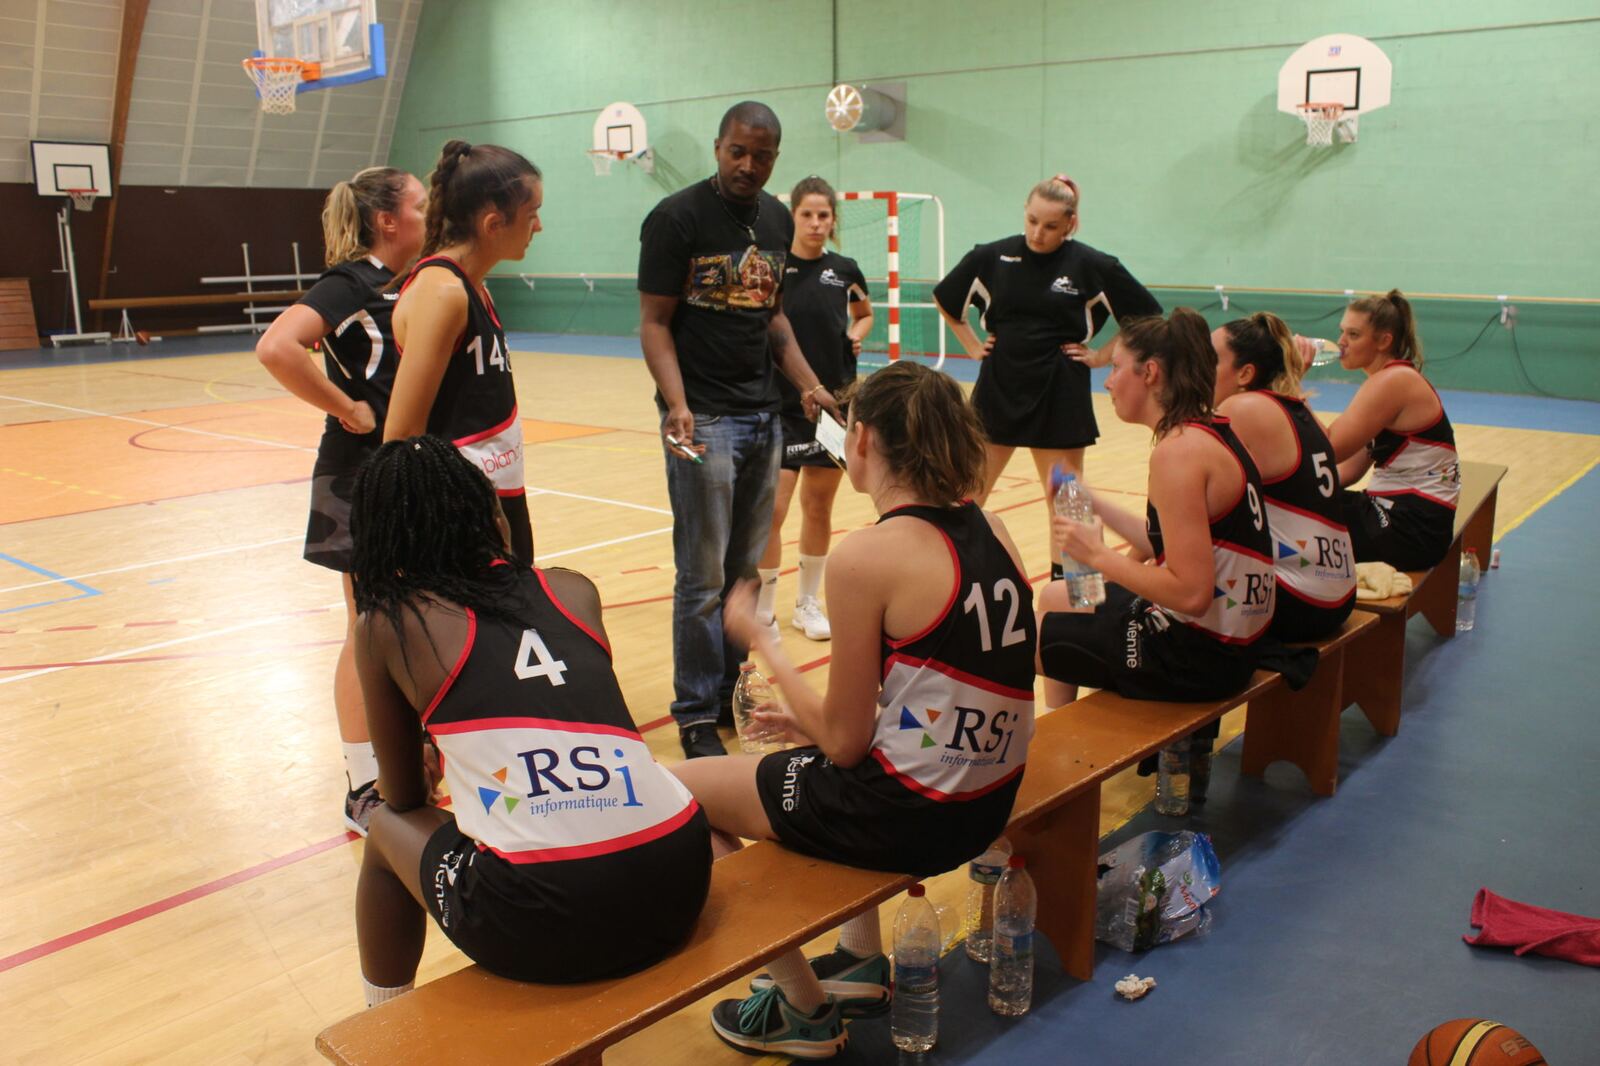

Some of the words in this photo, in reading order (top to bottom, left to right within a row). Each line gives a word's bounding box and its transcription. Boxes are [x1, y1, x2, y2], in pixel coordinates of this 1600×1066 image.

[1312, 452, 1334, 498] 5
[1247, 482, 1263, 531] 9
[1313, 535, 1351, 578] RSi
[963, 577, 1027, 652] 12
[514, 628, 568, 686] 4
[945, 706, 1019, 764] RSi
[517, 746, 643, 807] RSi
[530, 795, 618, 818] informatique
